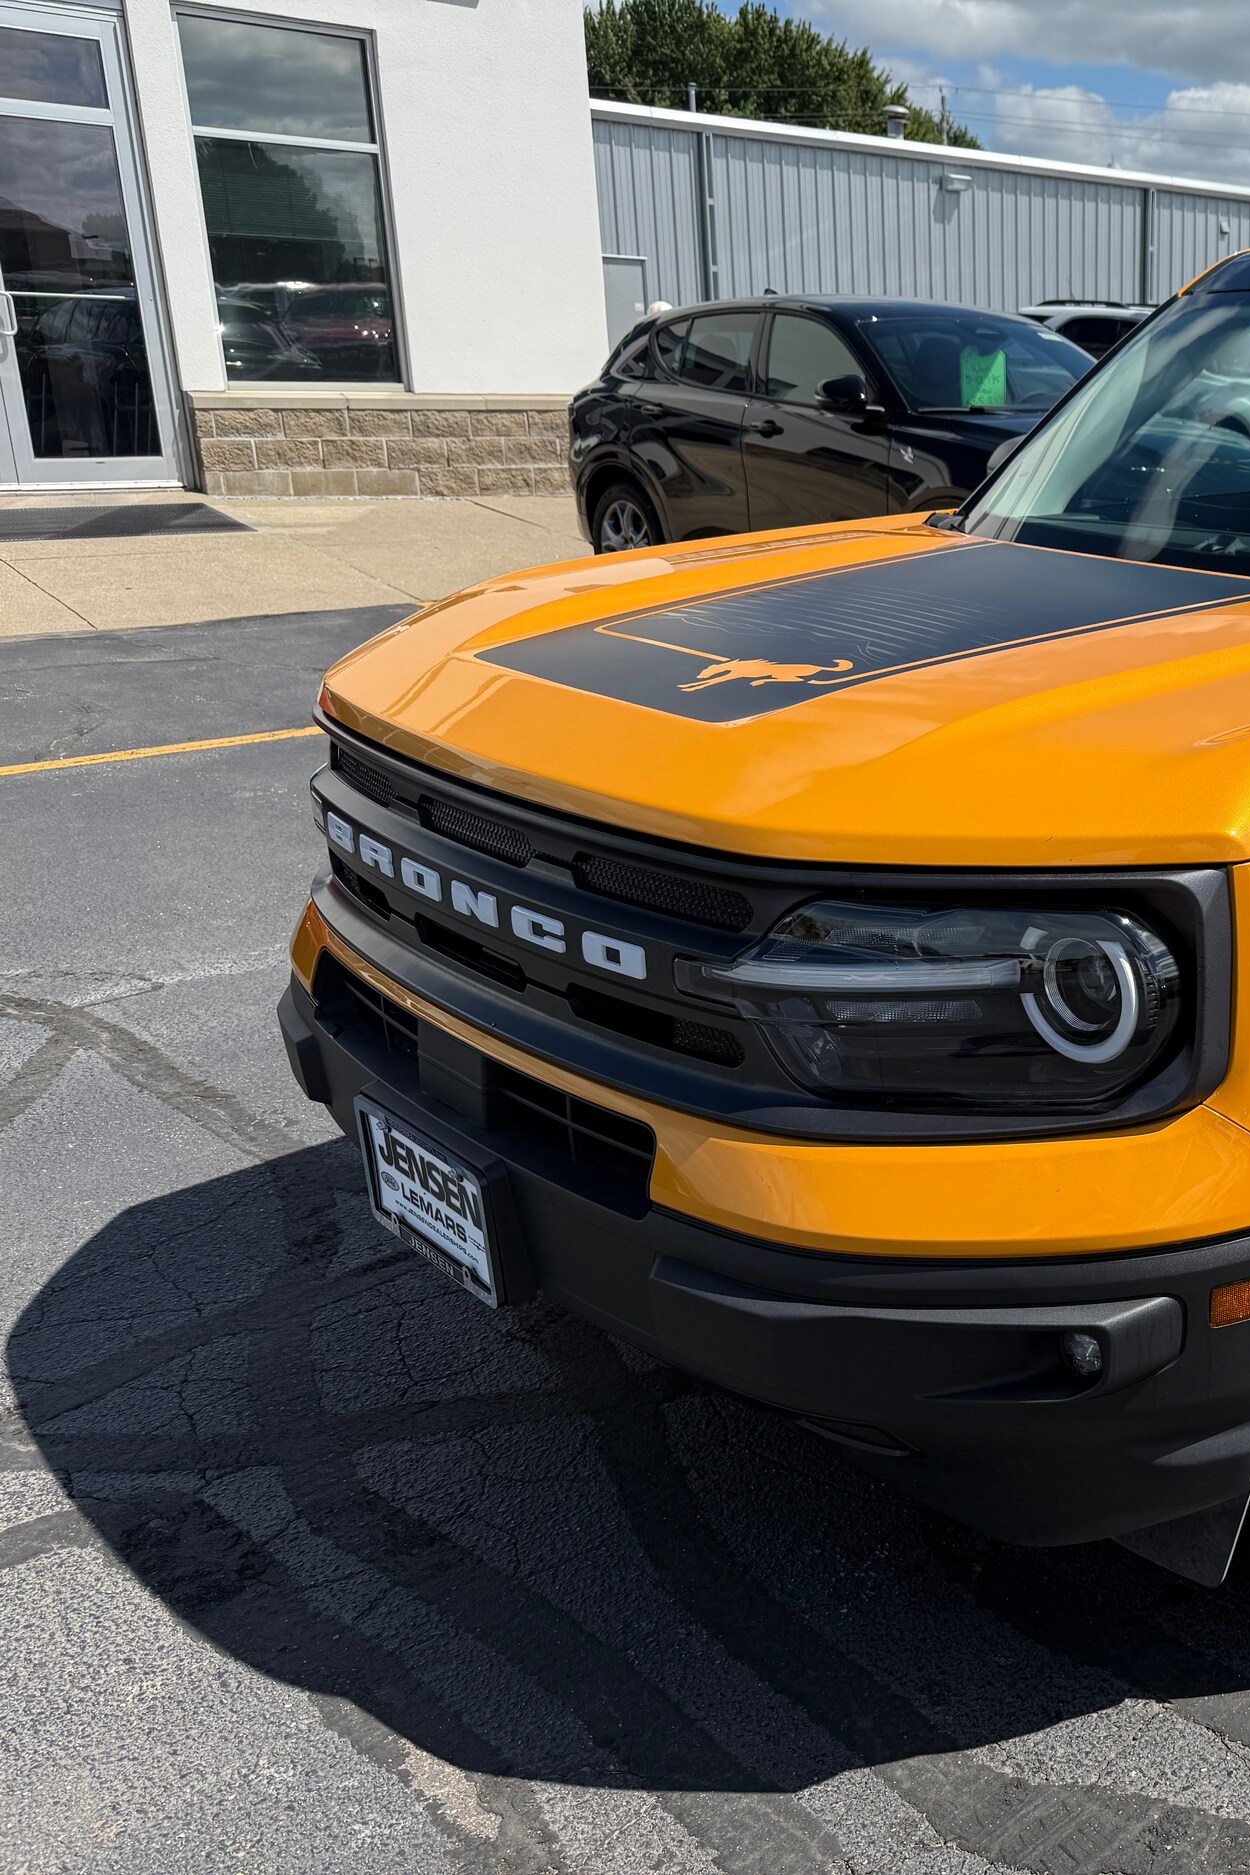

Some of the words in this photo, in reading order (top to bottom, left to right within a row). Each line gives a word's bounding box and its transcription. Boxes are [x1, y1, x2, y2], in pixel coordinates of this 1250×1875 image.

[326, 811, 647, 980] BRONCO
[378, 1133, 484, 1232] JENSEN
[400, 1182, 468, 1244] LEMARS
[408, 1236, 456, 1277] JENSEN
